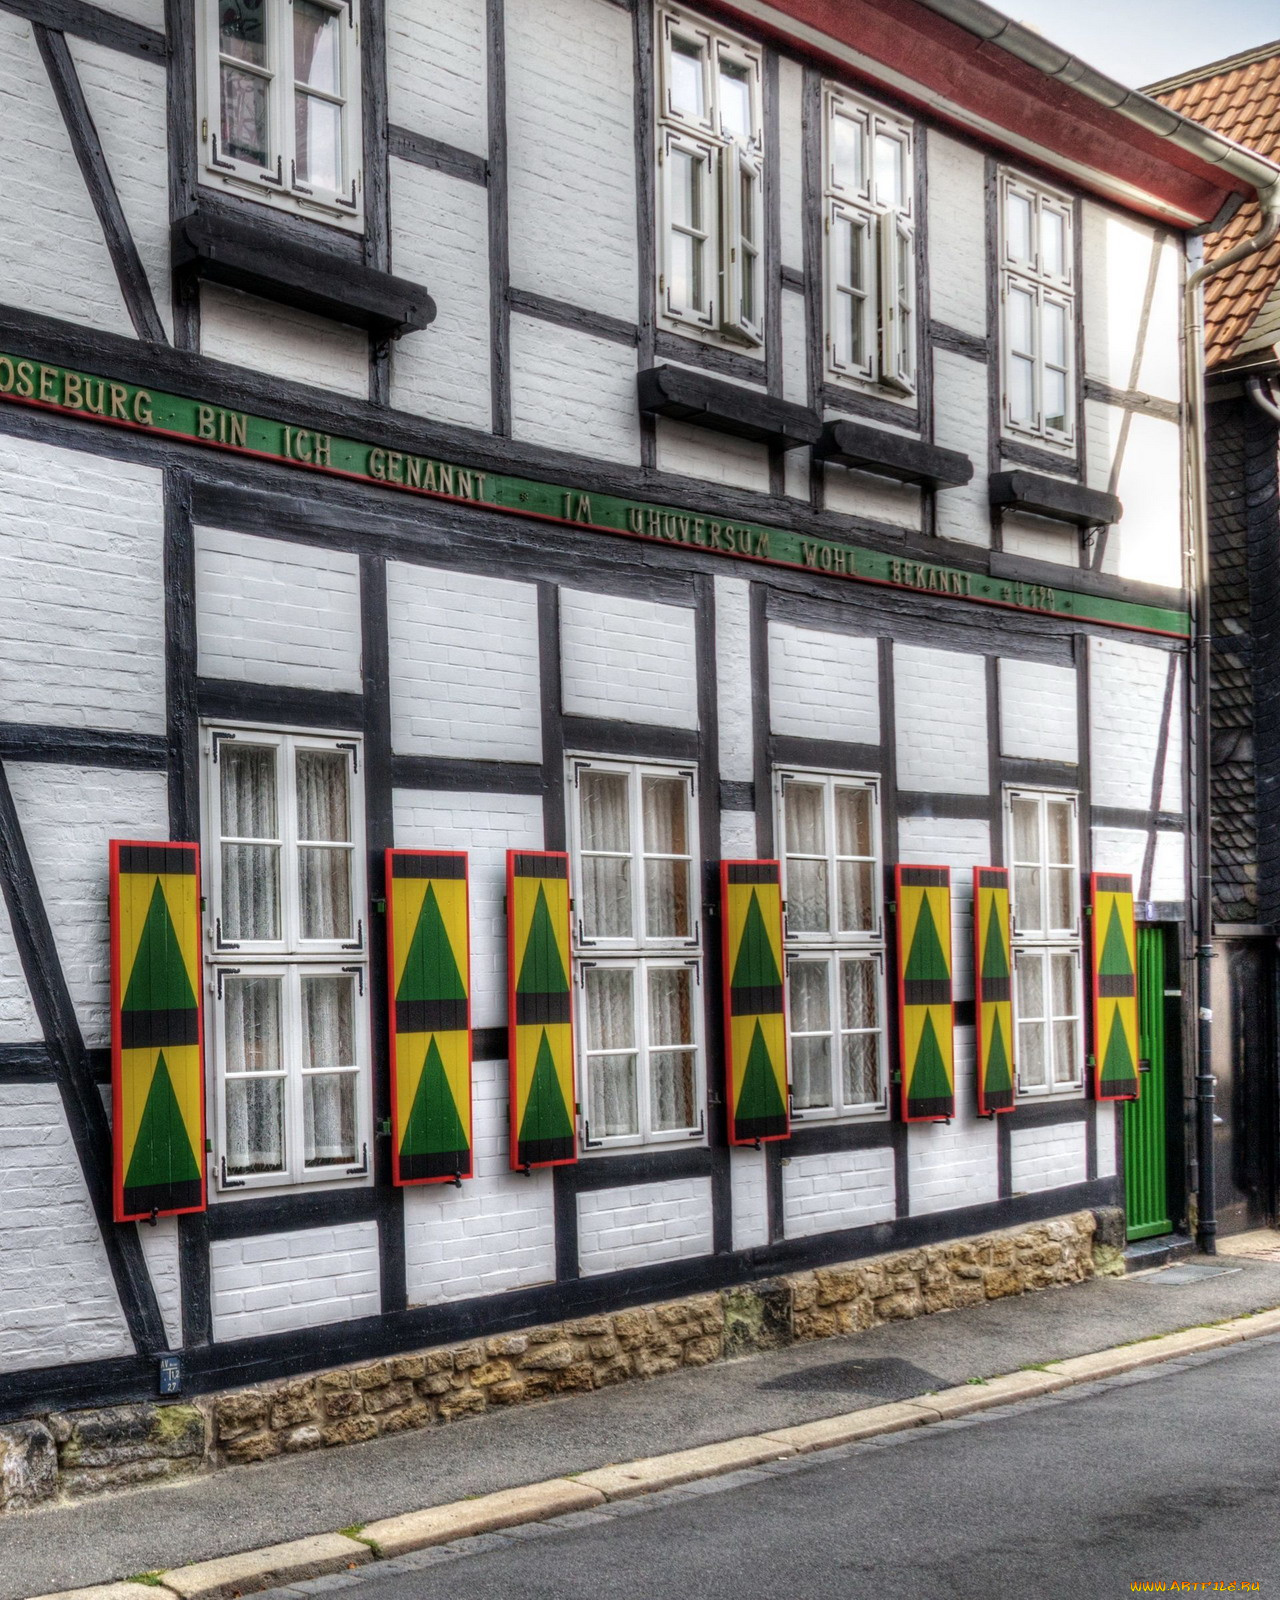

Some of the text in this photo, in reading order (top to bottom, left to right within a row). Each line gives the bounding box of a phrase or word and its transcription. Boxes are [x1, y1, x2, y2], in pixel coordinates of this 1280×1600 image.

[198, 405, 248, 447] BIN
[284, 425, 332, 467] ICH
[370, 447, 486, 501] GENANNT
[565, 491, 593, 525] IM
[631, 508, 771, 558] UHUVERSUM
[802, 541, 859, 577] WOHL
[892, 559, 972, 596] BEKANNT
